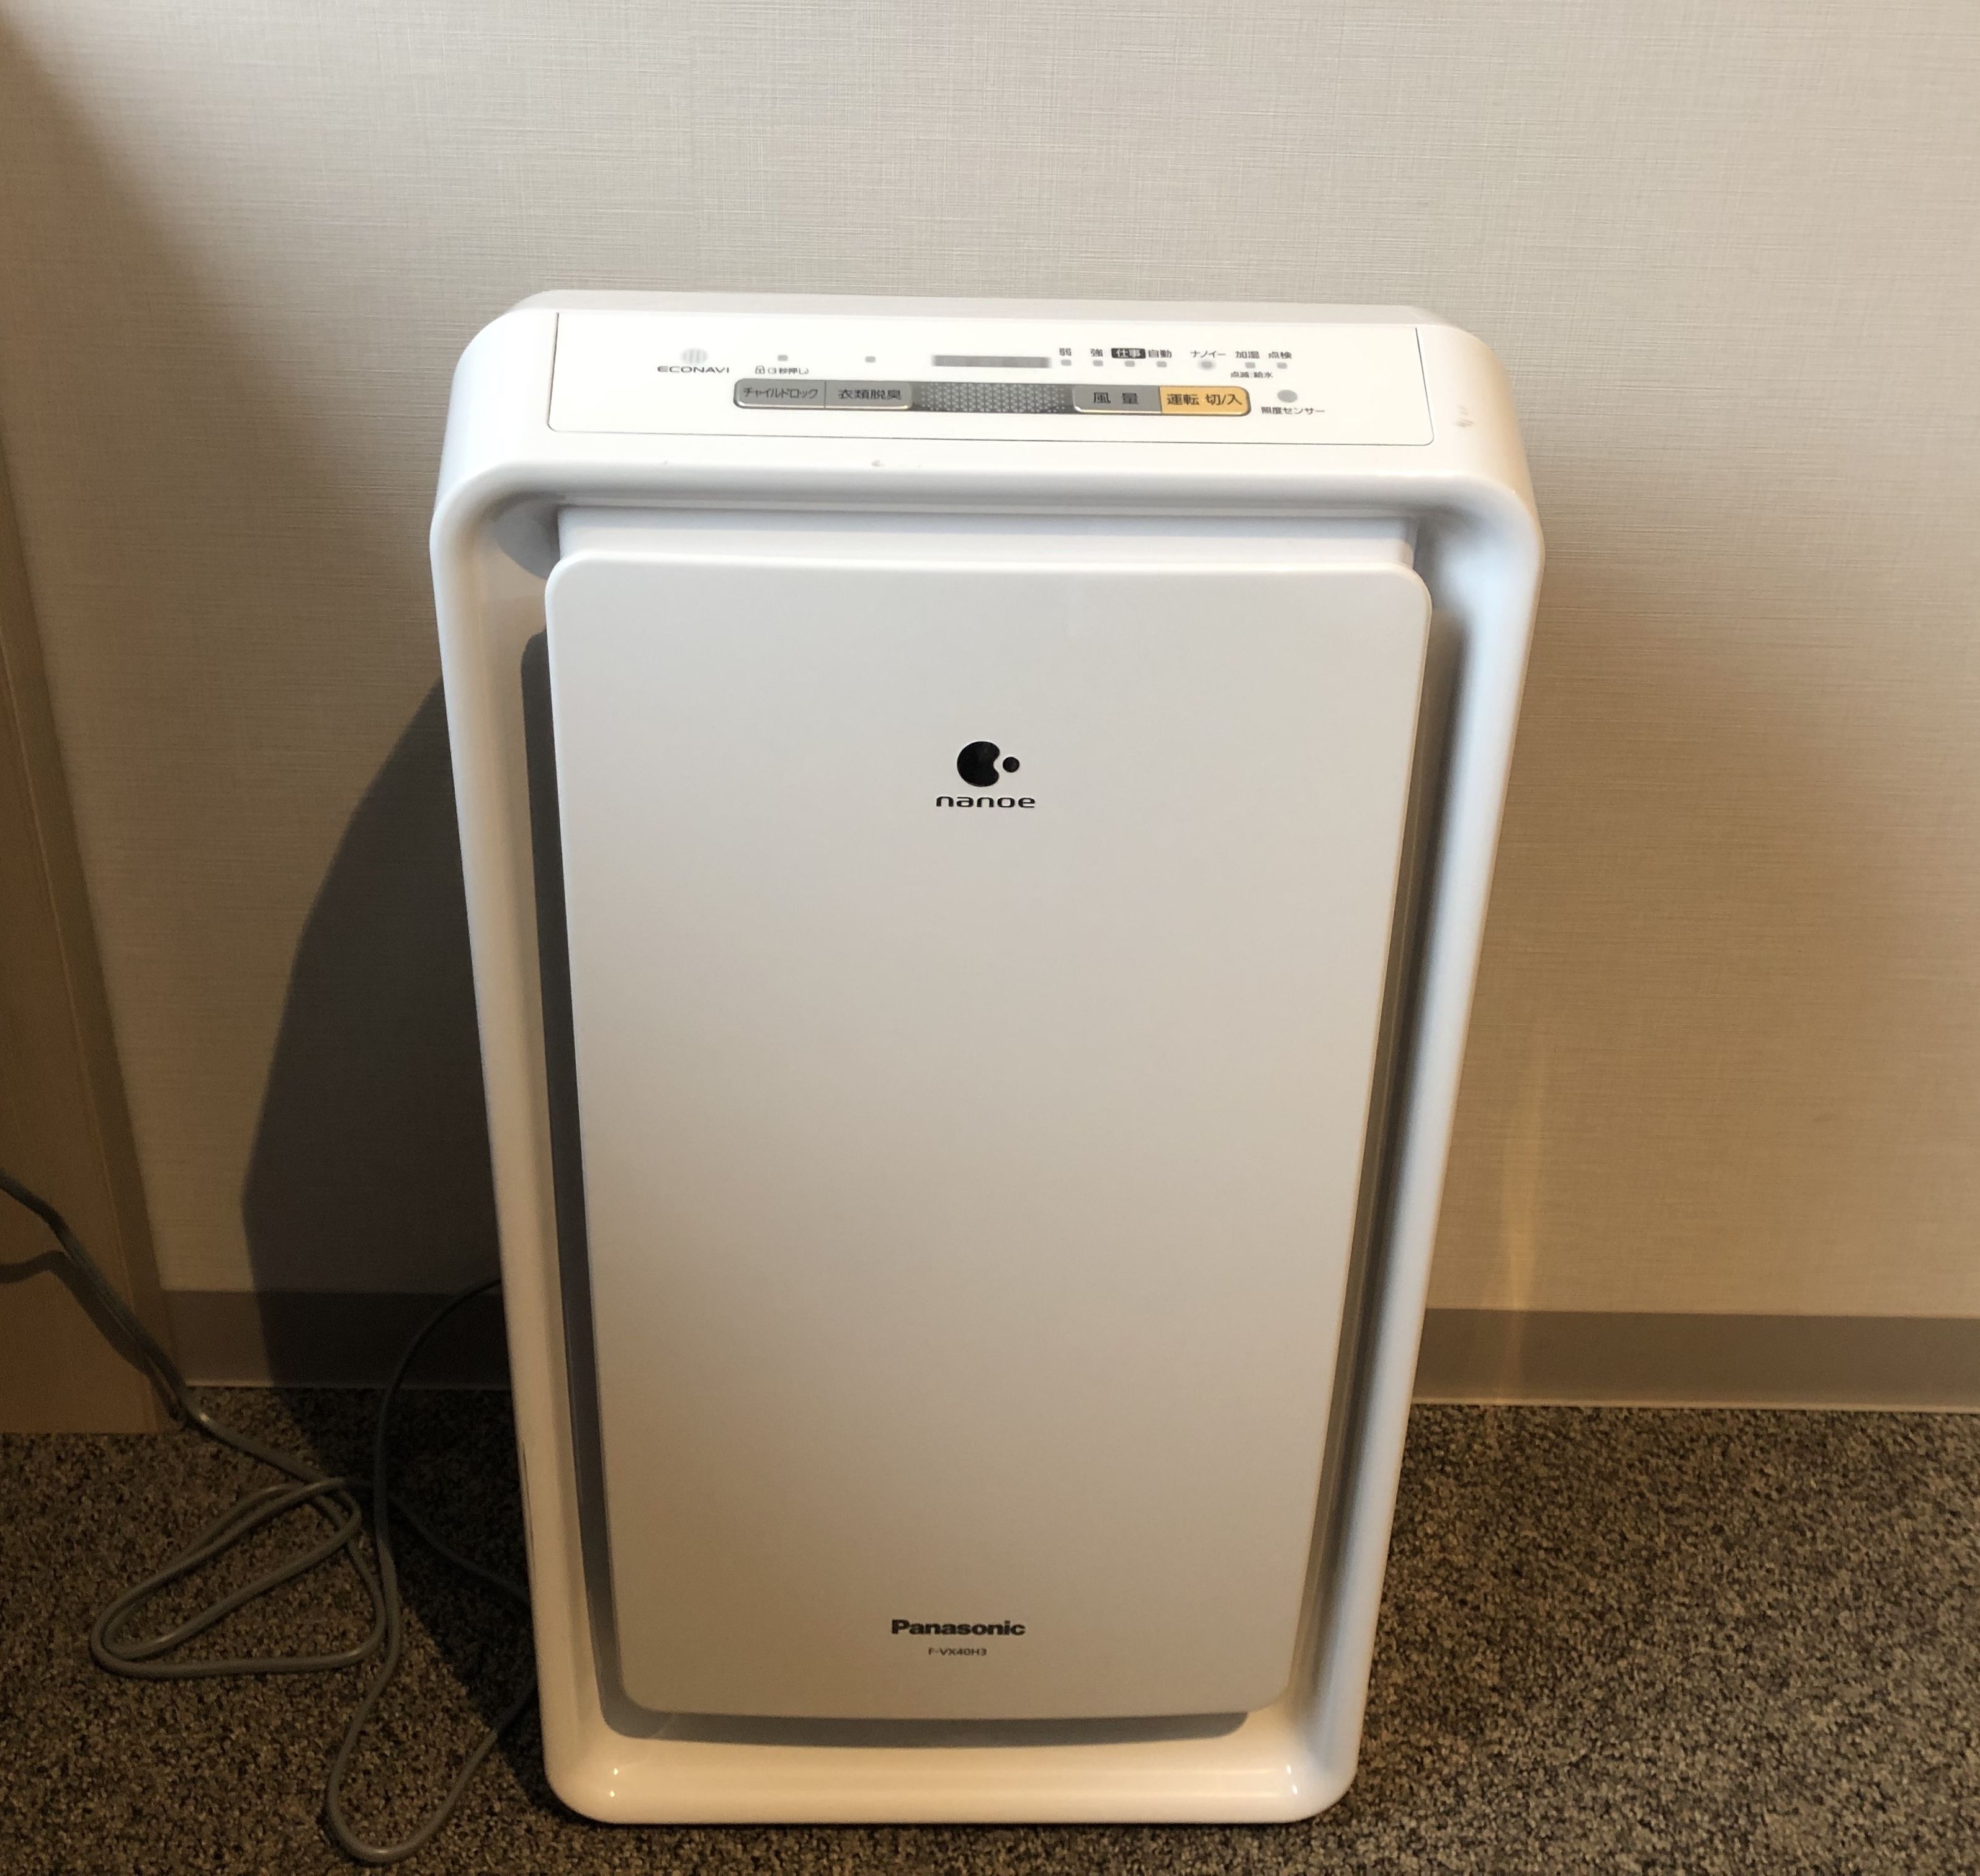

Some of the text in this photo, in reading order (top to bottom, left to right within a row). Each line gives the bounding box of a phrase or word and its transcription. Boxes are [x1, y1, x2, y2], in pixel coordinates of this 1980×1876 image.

[1059, 348, 1072, 357] 弱
[1148, 349, 1173, 359] 自動
[1190, 350, 1226, 359] ナノイー
[1235, 351, 1260, 359] 加湿
[1268, 351, 1292, 359] 点検
[657, 366, 730, 374] ECONAVI
[743, 387, 818, 400] チャイルドロック
[838, 388, 902, 400] 衣類脱臭
[1167, 393, 1200, 406] 運転
[1260, 406, 1326, 416] 照度センサー
[936, 796, 1036, 809] nanoe
[891, 1618, 1026, 1636] Panasonic
[928, 1646, 987, 1657] F-VX40H3
